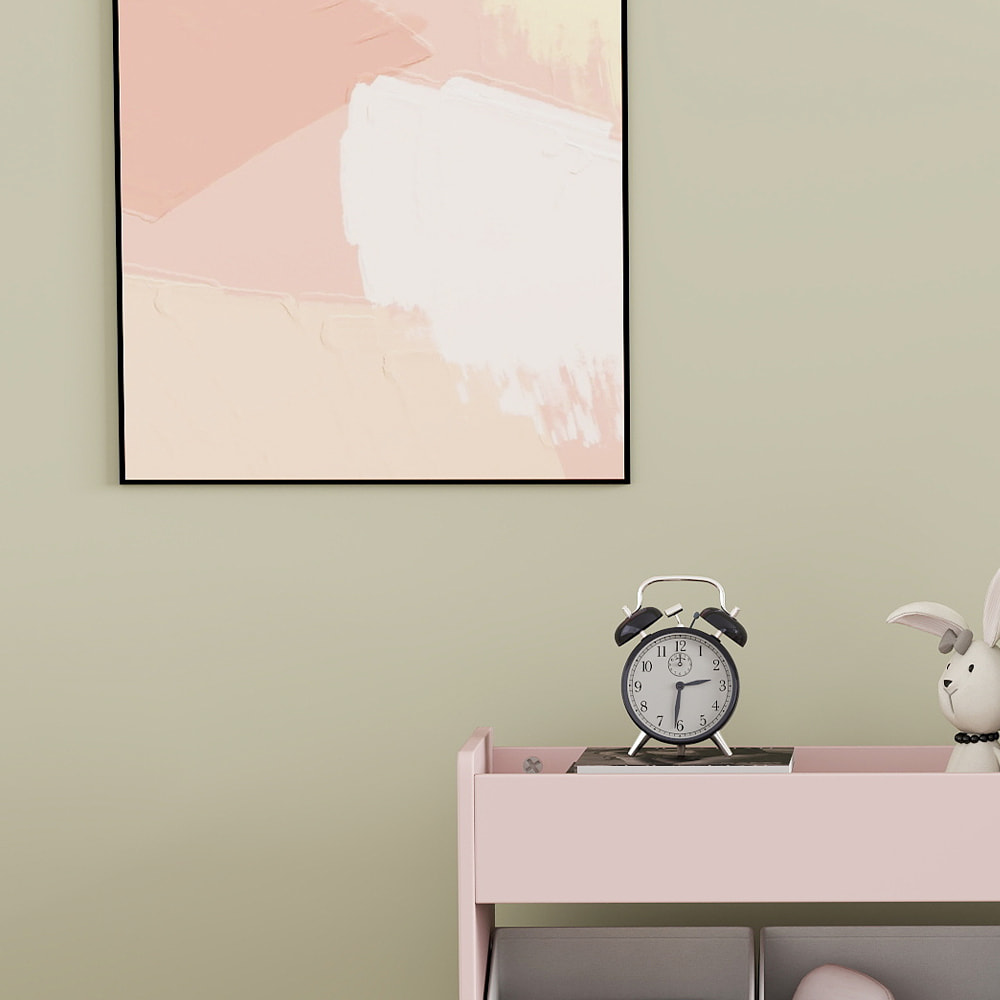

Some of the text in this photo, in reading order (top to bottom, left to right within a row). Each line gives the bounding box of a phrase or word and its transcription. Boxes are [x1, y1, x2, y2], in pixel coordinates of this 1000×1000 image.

[657, 645, 666, 657] 11
[675, 640, 687, 652] 12
[698, 645, 703, 656] 1
[642, 660, 653, 672] 10
[712, 659, 720, 671] 2
[634, 680, 642, 692] 9
[719, 680, 727, 692] 3
[640, 701, 648, 712] 8
[711, 700, 720, 711] 4
[656, 715, 664, 727] 7
[676, 719, 684, 731] 6
[699, 714, 707, 726] 5
